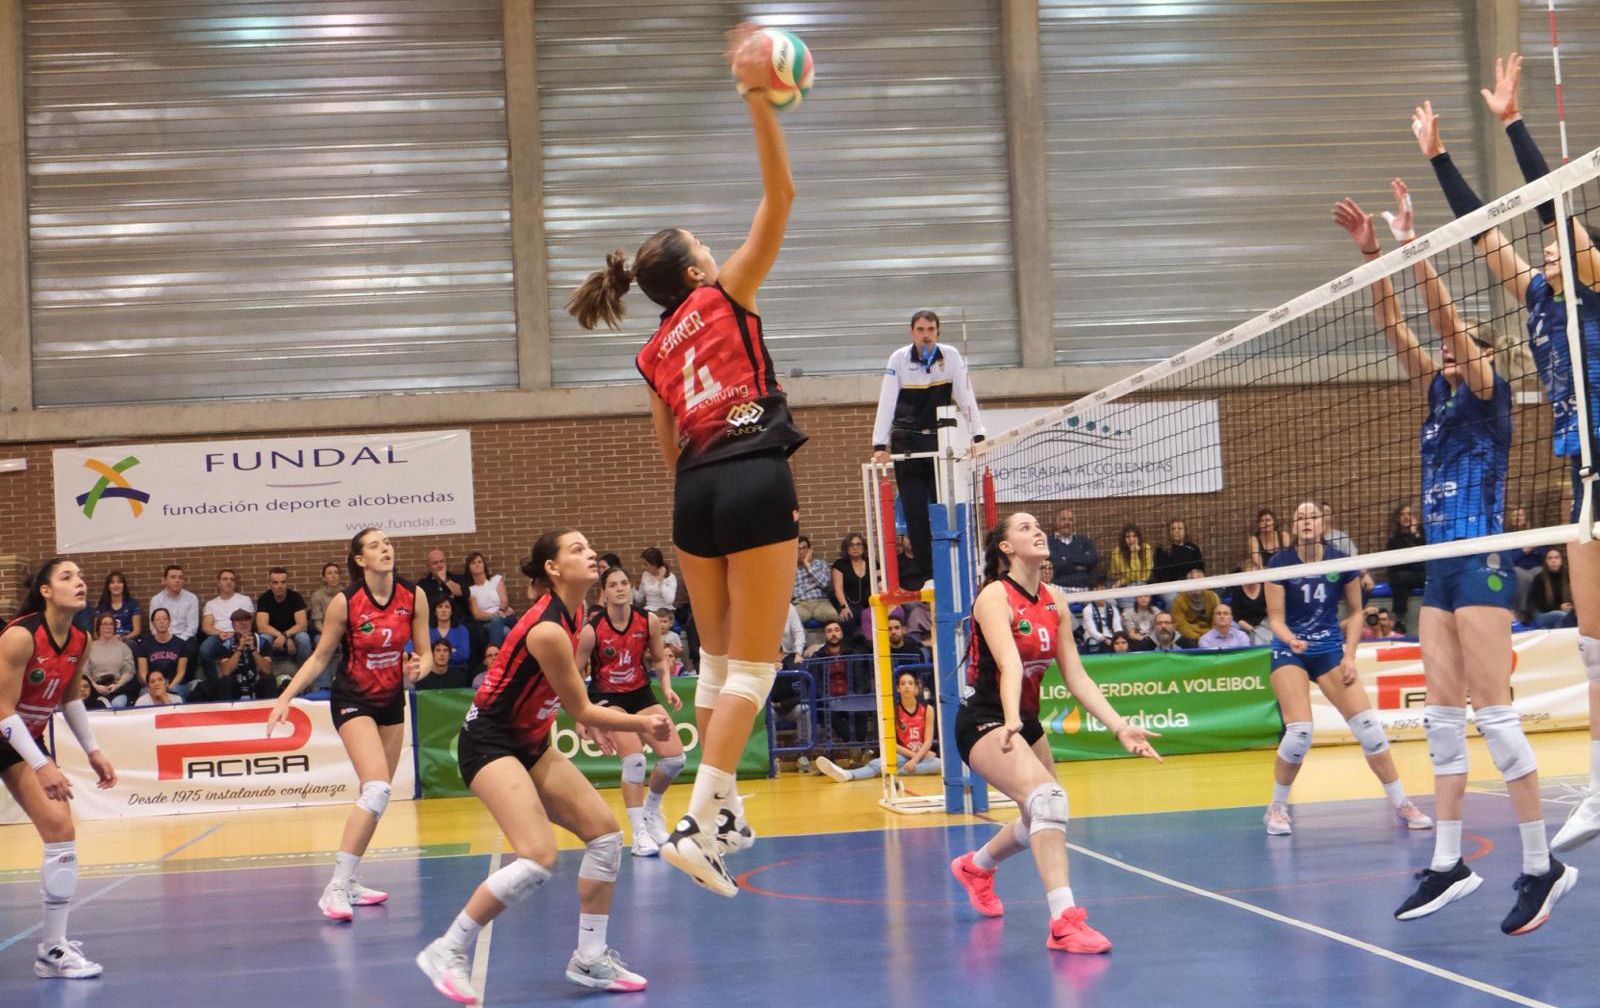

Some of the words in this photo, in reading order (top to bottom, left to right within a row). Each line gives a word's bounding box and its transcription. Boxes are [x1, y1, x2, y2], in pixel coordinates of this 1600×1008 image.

[681, 346, 723, 411] 4
[205, 442, 408, 473] FUNDAL
[162, 501, 259, 516] fundación
[265, 495, 341, 513] deporte
[347, 491, 456, 507] alcobendas
[345, 517, 457, 531] www.fundal.es
[1301, 583, 1327, 603] 14
[381, 628, 392, 648] 2
[1037, 627, 1051, 652] 9
[619, 650, 631, 667] 14
[42, 678, 60, 699] 11
[1099, 680, 1179, 698] ERDROLA
[1183, 676, 1266, 694] VOLEIBOL
[909, 727, 920, 740] 15
[1393, 718, 1420, 730] 1975
[128, 791, 168, 805] Desde
[172, 789, 203, 803] 1975
[205, 785, 276, 801] instalando
[280, 781, 347, 799] confianza
